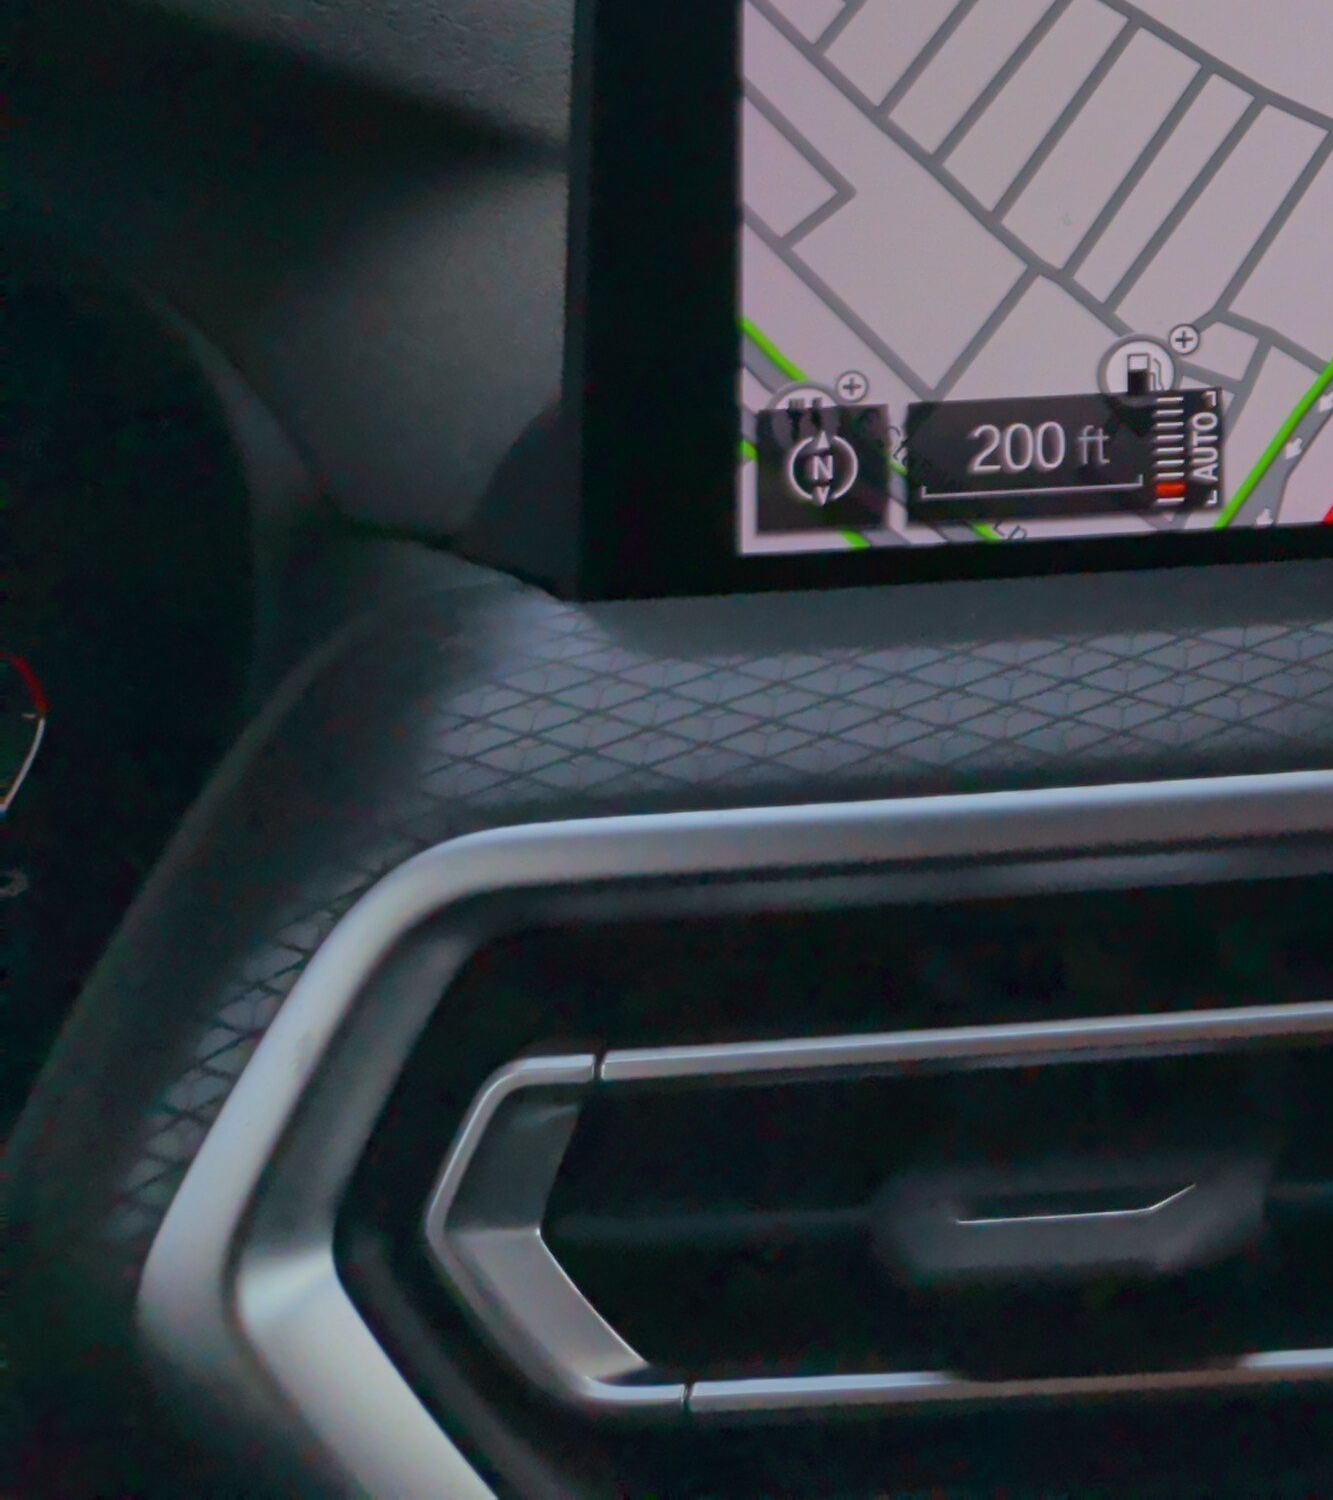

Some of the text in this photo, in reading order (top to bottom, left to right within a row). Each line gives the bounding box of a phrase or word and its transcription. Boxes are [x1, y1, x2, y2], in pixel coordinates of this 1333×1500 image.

[813, 454, 834, 481] N
[968, 421, 1110, 473] 200 ft
[1190, 411, 1219, 483] AUTO
